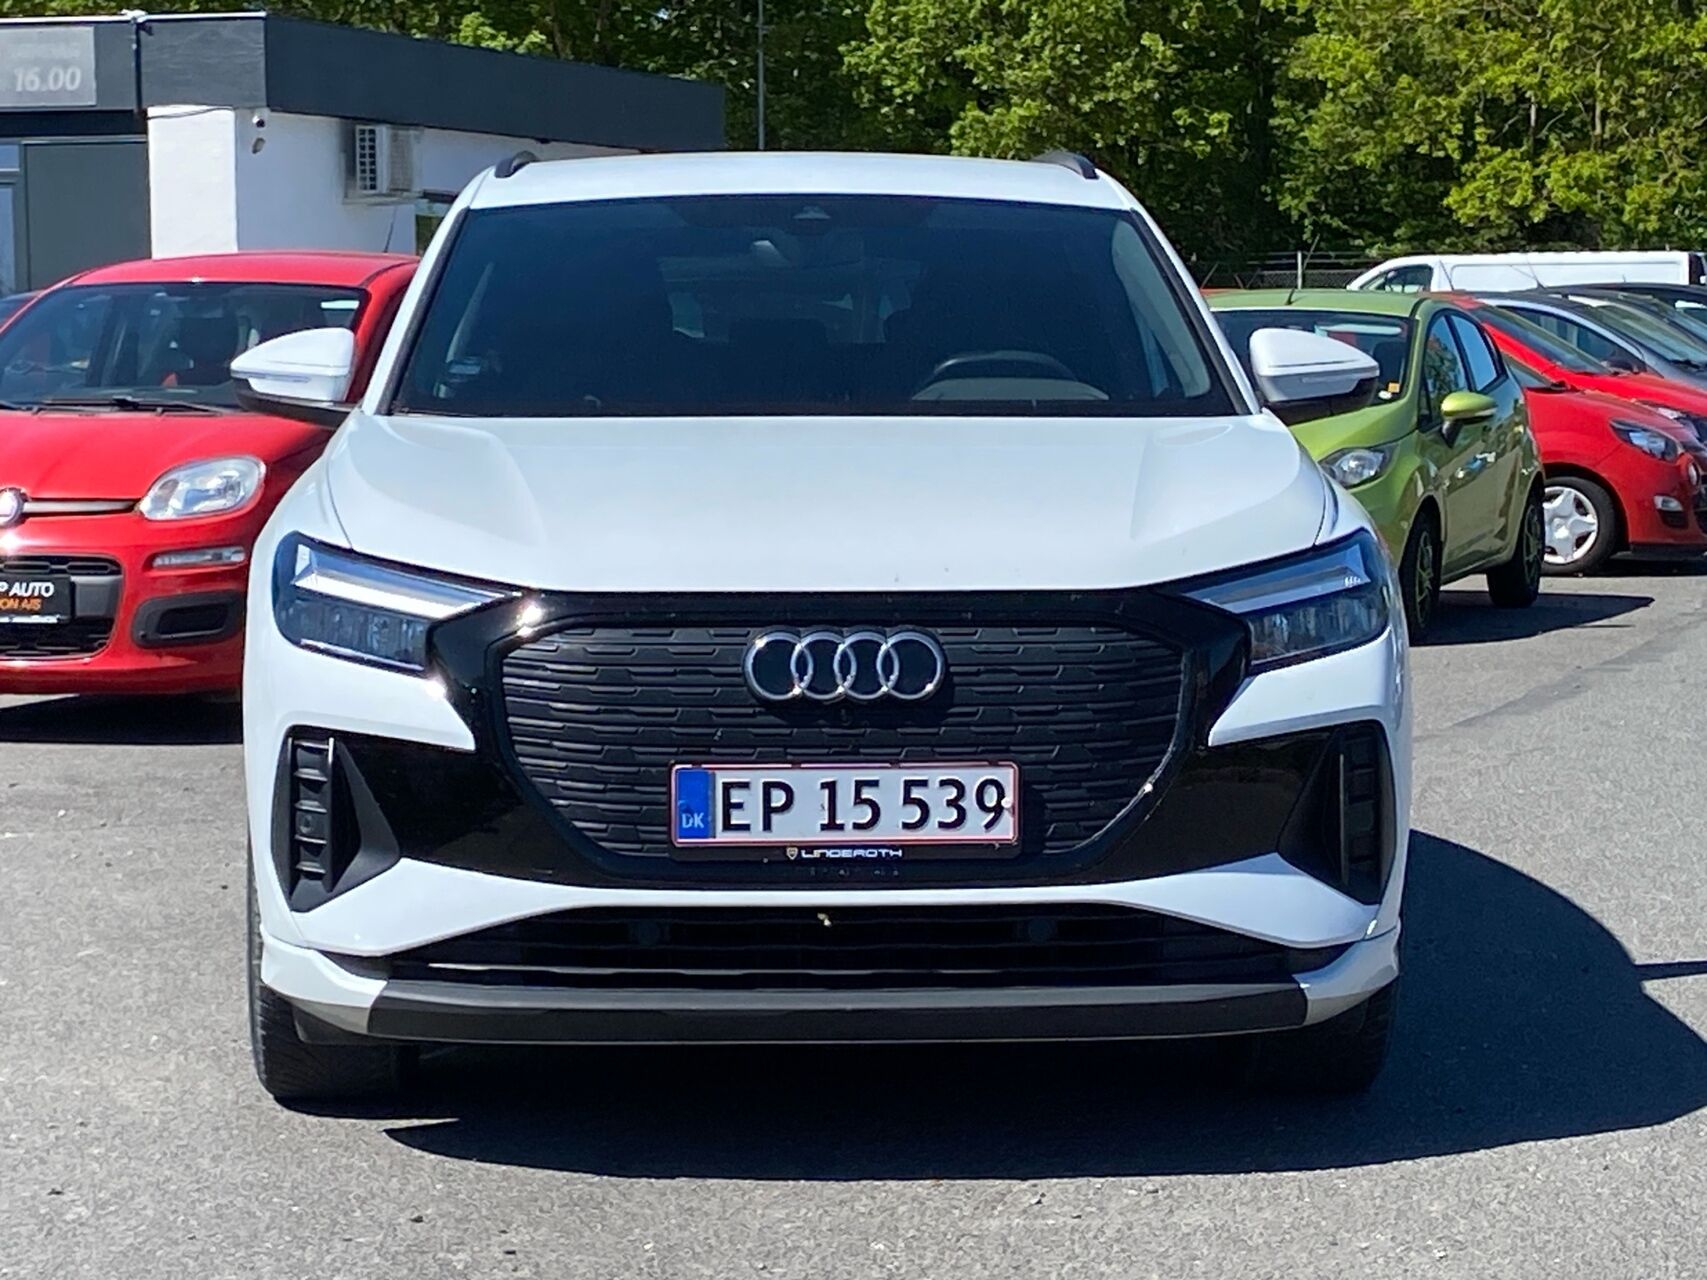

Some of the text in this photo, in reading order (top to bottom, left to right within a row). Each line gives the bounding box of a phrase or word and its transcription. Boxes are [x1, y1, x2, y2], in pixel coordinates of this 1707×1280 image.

[14, 66, 82, 92] 16.00
[8, 582, 55, 597] AUTO
[721, 778, 1007, 832] EP 15 539
[681, 813, 705, 829] DK
